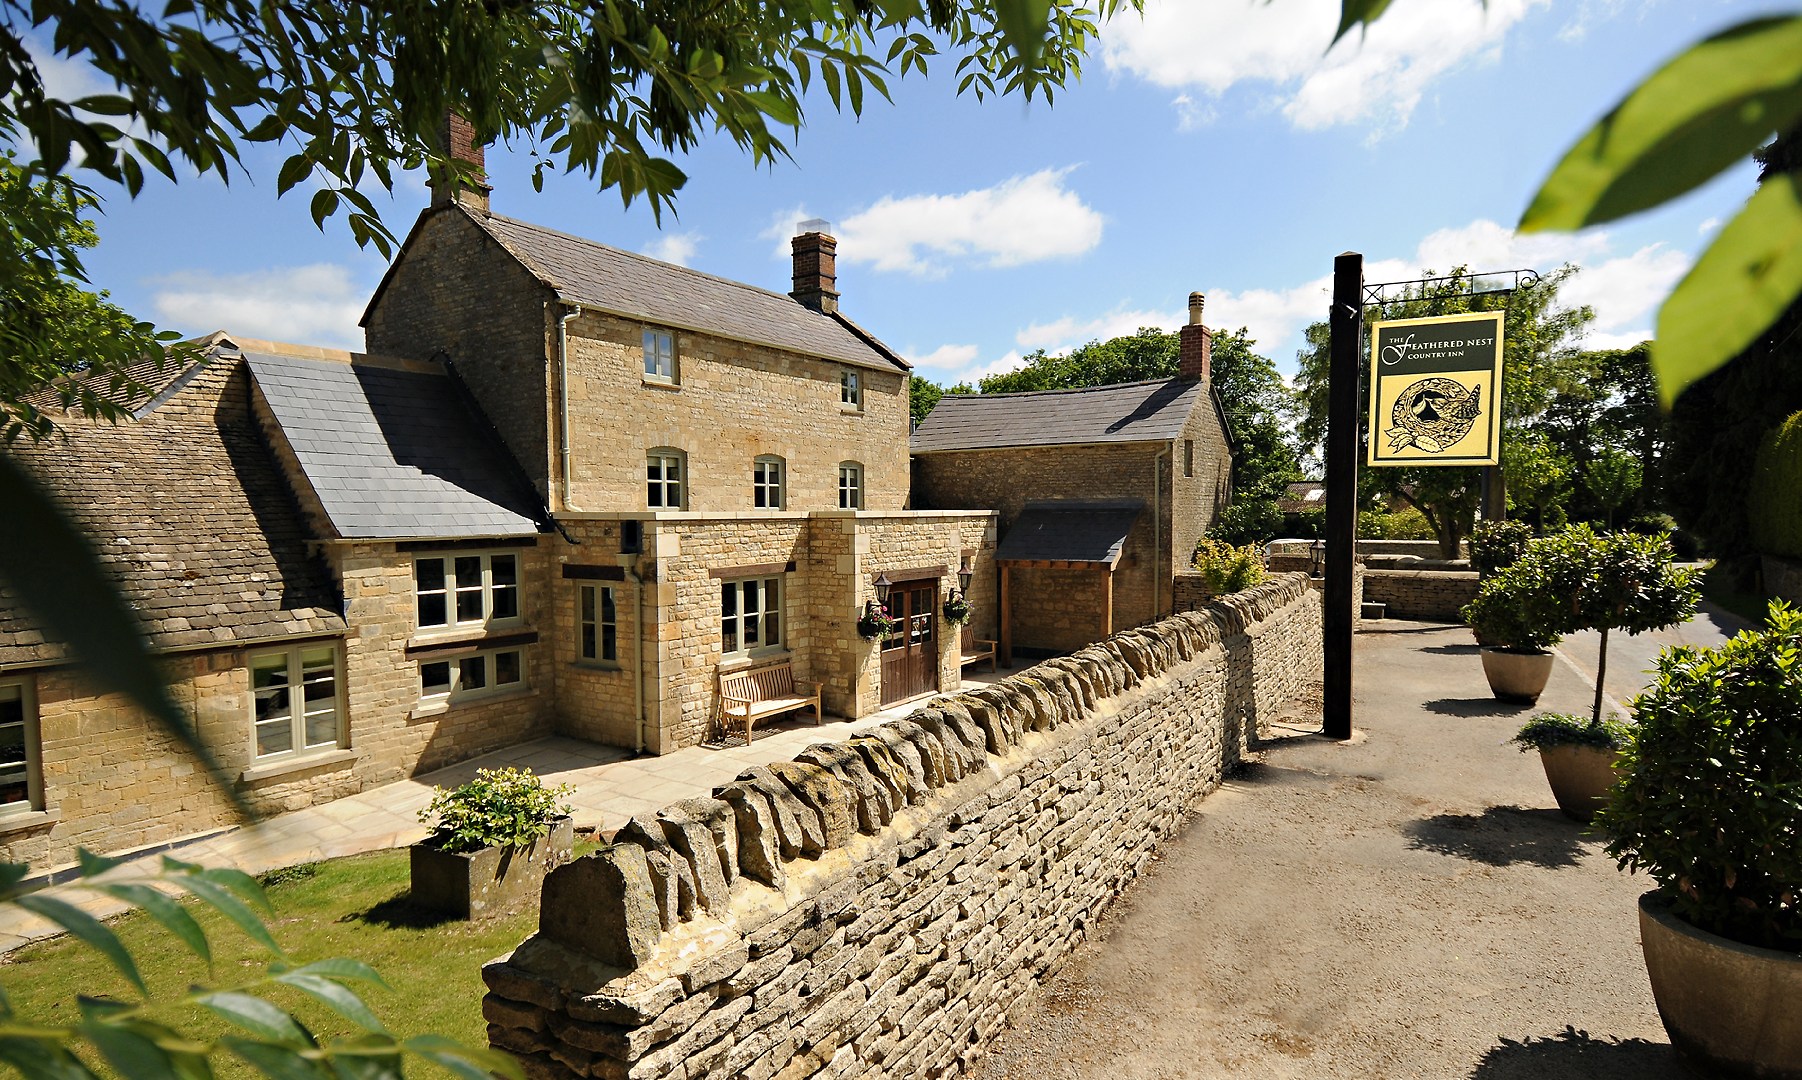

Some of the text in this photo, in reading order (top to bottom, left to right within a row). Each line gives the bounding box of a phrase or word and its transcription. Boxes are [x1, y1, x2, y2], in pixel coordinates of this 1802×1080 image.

[1381, 333, 1493, 365] FEATHERED NEST
[1407, 352, 1446, 360] COUNTRY
